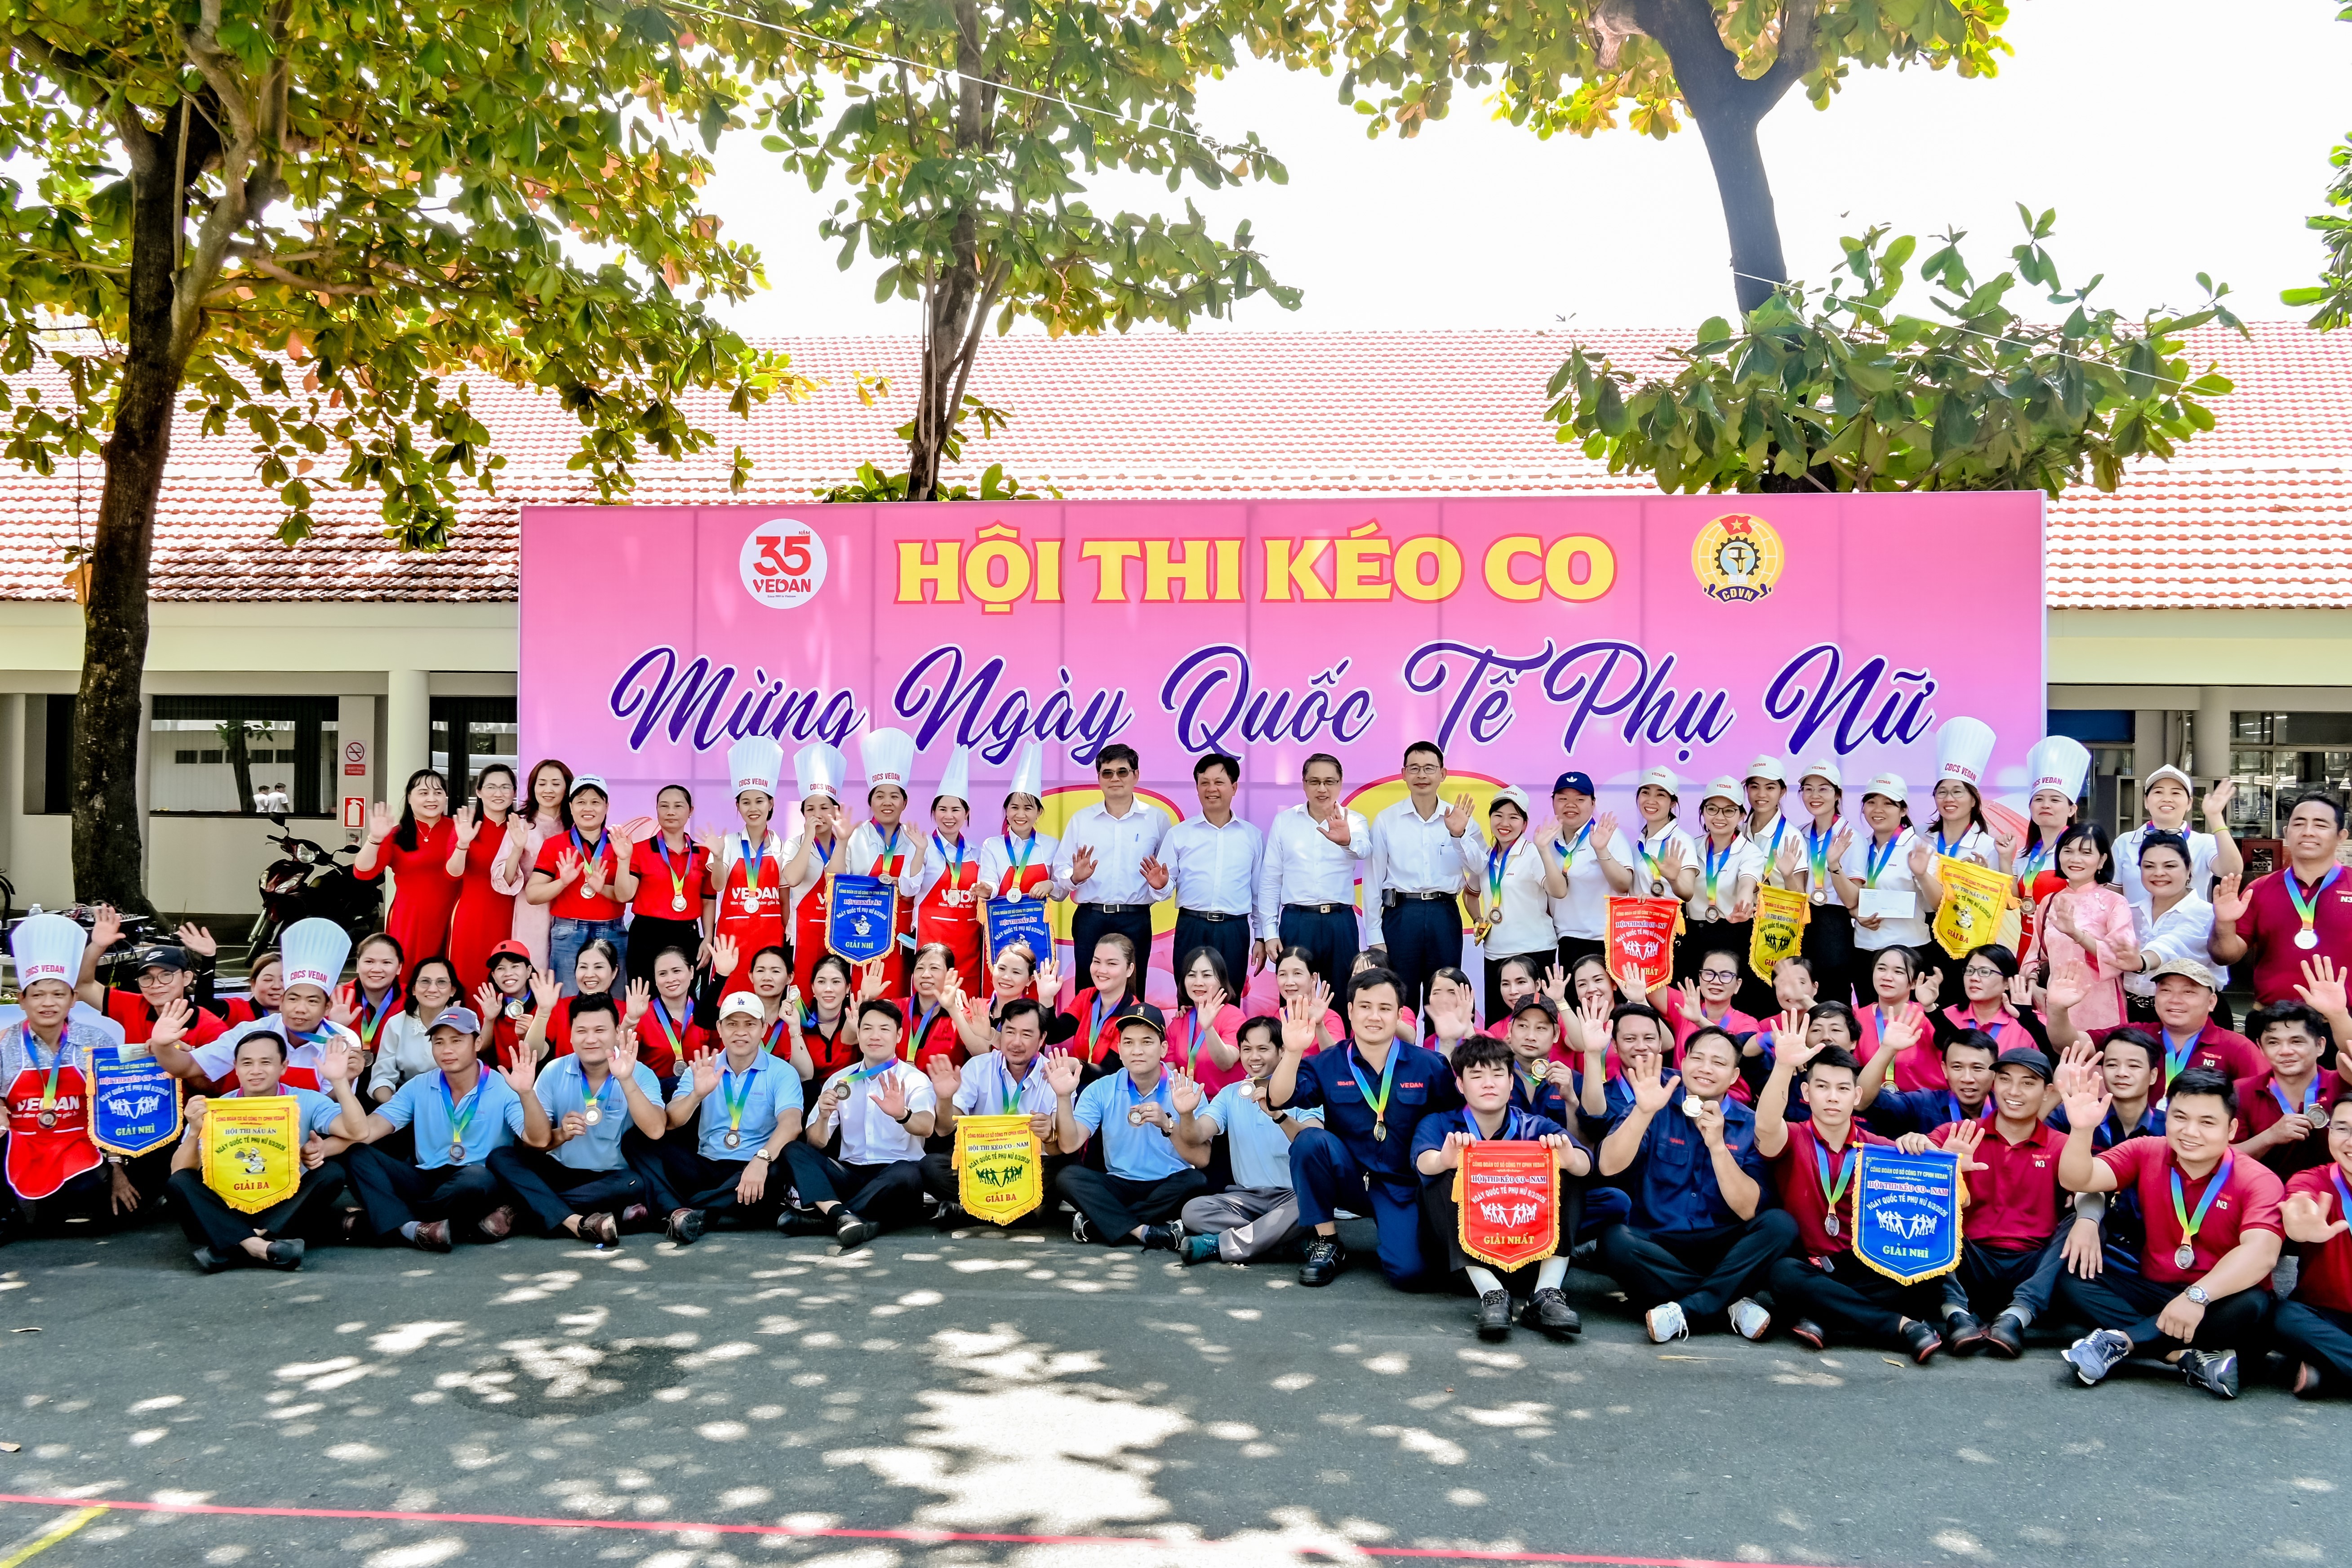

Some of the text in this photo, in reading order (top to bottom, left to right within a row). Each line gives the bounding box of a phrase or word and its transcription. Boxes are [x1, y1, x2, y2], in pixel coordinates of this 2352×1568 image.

[753, 536, 811, 576] 35
[893, 517, 1618, 615] HỘI THI KÉO CO
[753, 579, 811, 592] VEDAN
[893, 645, 1134, 766] Ngày
[1160, 644, 1376, 762] Quốc
[1542, 640, 1736, 763] Phụ
[1763, 643, 1936, 756] Nữ
[885, 773, 900, 782] VEDAN
[1961, 767, 1977, 782] VEDAN
[752, 778, 768, 787] VEDAN
[825, 784, 836, 796] VEDAN
[845, 940, 860, 948] GIẢI
[1960, 935, 1969, 943] BA
[41, 965, 64, 974] VEDAN
[308, 970, 327, 983] VEDAN
[2203, 1059, 2215, 1067] N3
[116, 1124, 136, 1136] GIẢI
[968, 1159, 979, 1169] NGÀY
[980, 1153, 991, 1163] QUỐC
[1014, 1155, 1031, 1164] 8/3/2026
[234, 1180, 254, 1190] GIẢI
[1472, 1175, 1485, 1184] HỘI
[1500, 1174, 1514, 1183] KÉO
[1868, 1180, 1883, 1190] HỘI
[1899, 1182, 1914, 1192] KÉO
[1931, 1188, 1948, 1196] NAM
[986, 1192, 1003, 1203] GIẢI
[1471, 1191, 1485, 1204] NGÀY
[1485, 1186, 1499, 1197] QUỐC
[1508, 1187, 1518, 1195] PHỤ
[1528, 1190, 1547, 1204] 8/3/2026
[1866, 1198, 1882, 1210] NGÀY
[1882, 1193, 1897, 1204] QUỐC
[1907, 1195, 1918, 1206] PHỤ
[1927, 1201, 1948, 1217] 8/3/2026
[2216, 1199, 2228, 1209] N3
[1484, 1232, 1534, 1244] GIẢI NHẤT
[1883, 1243, 1929, 1258] GIẢI NHÌ
